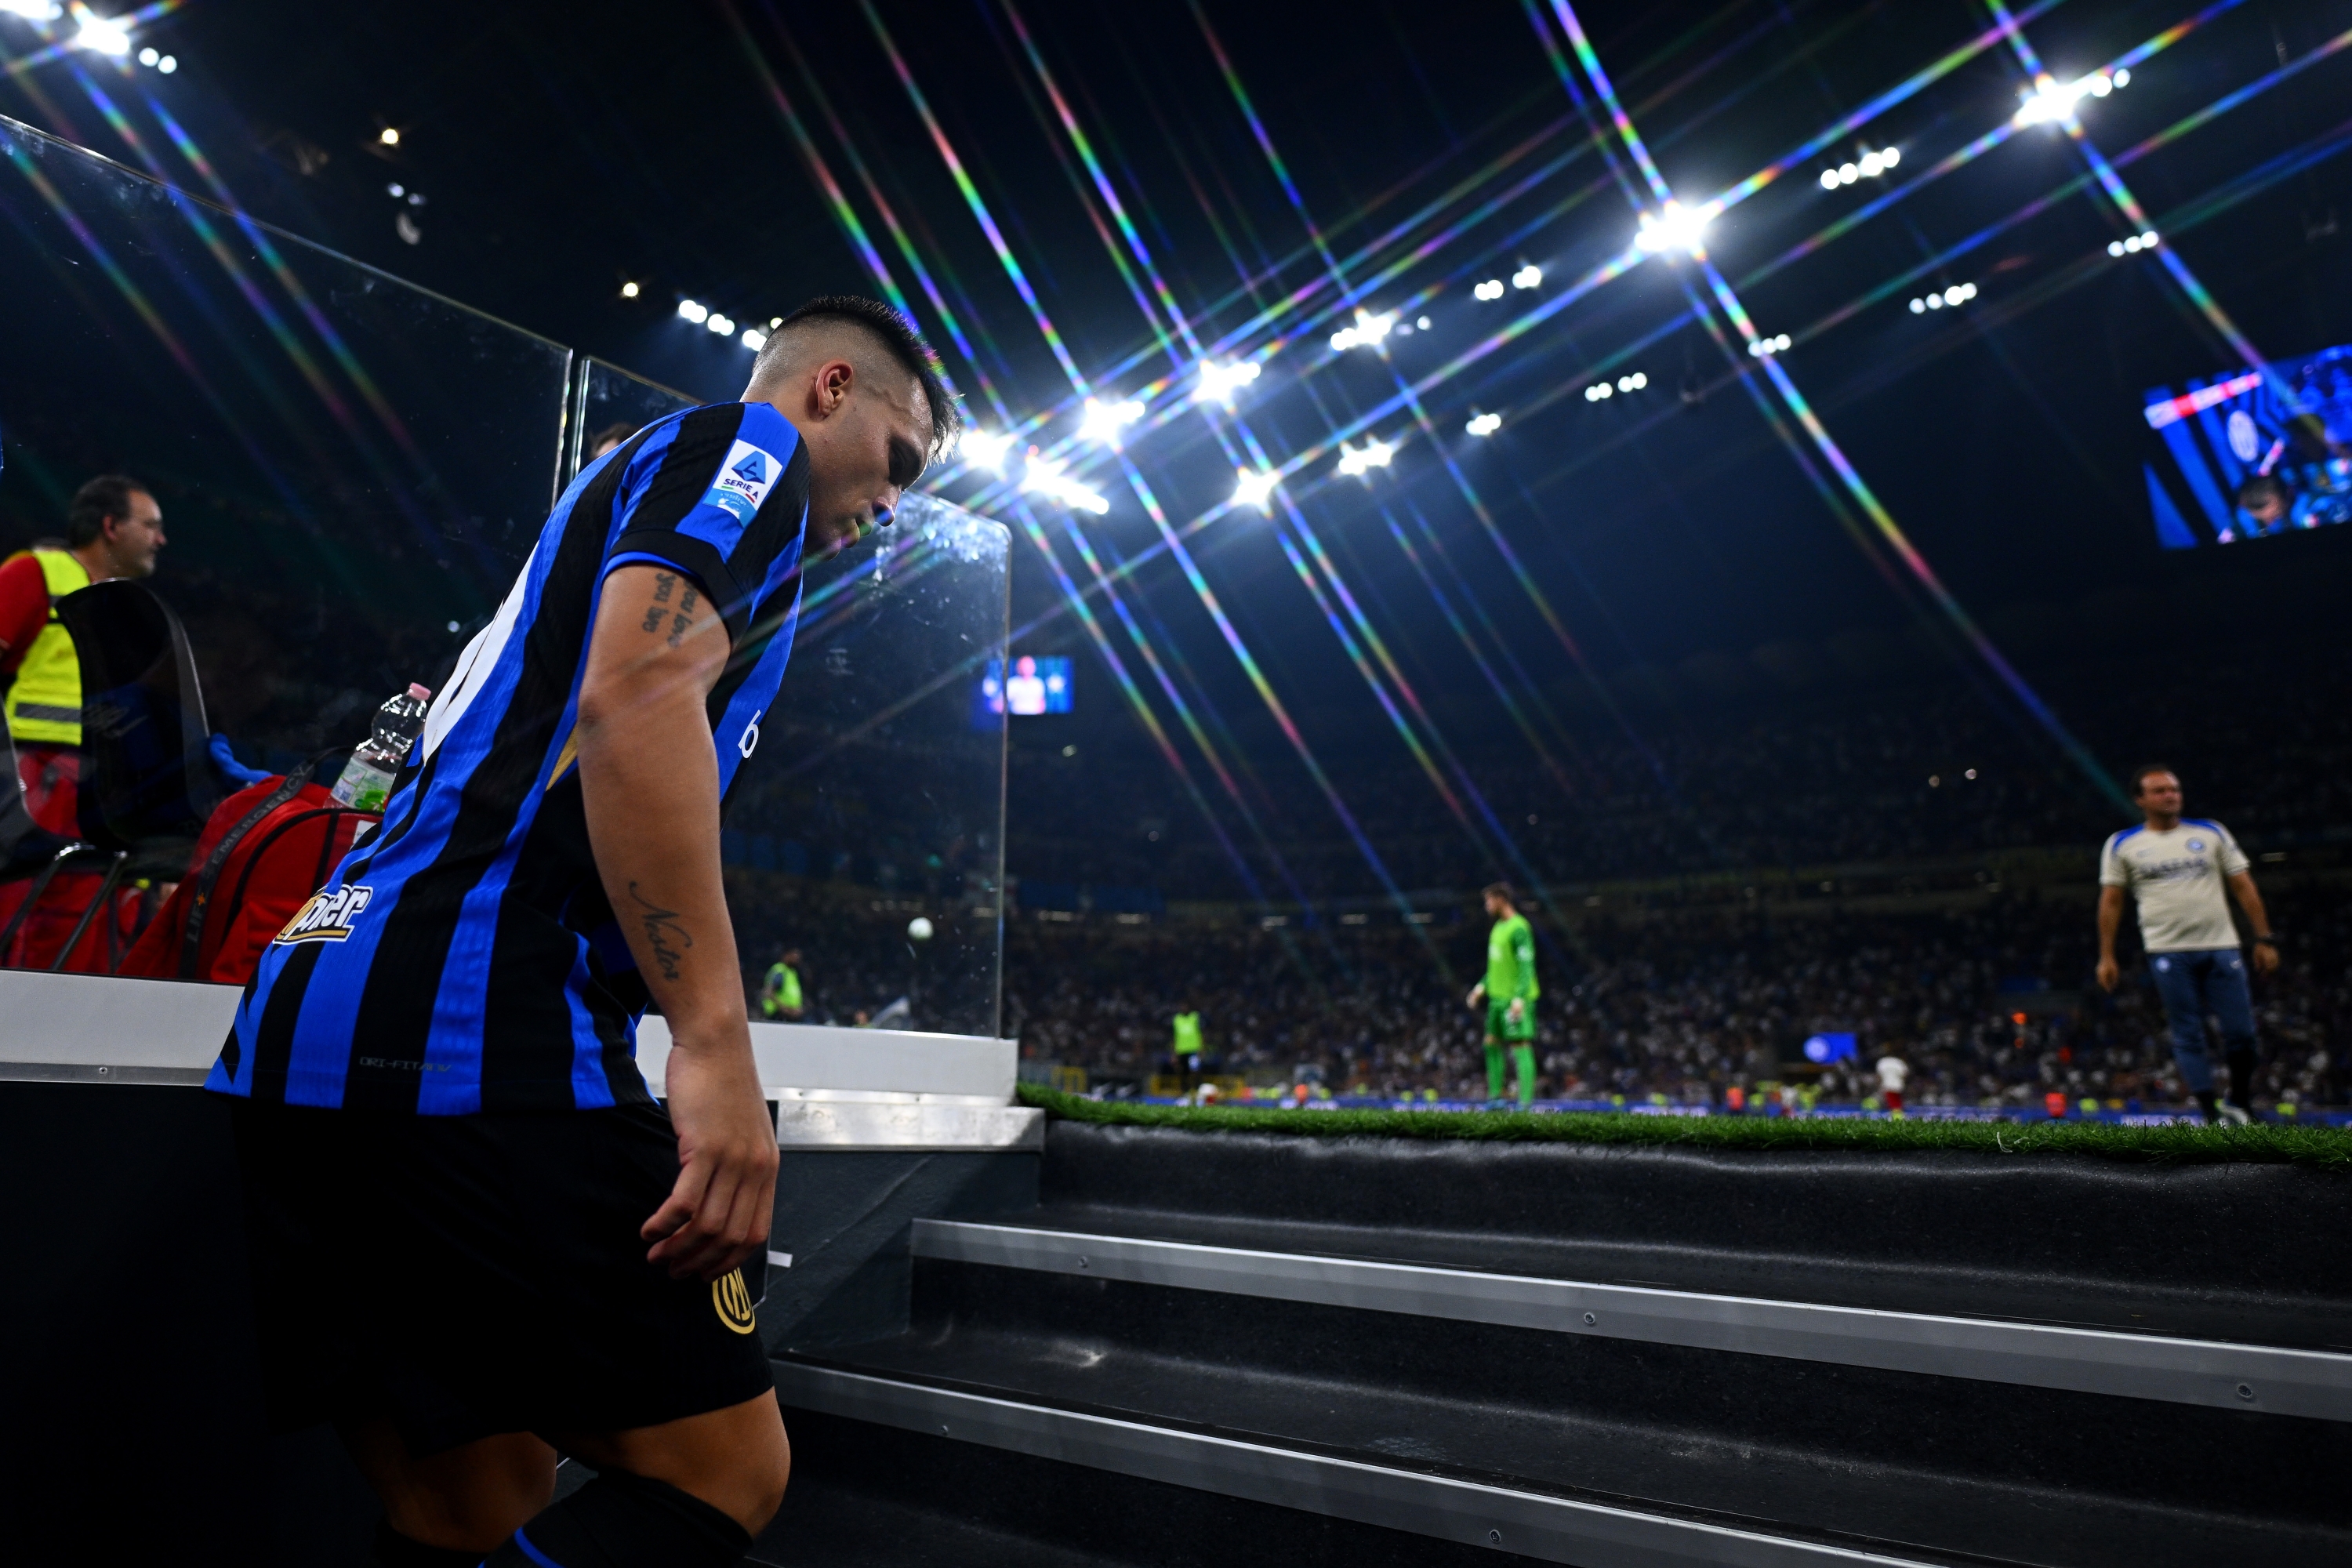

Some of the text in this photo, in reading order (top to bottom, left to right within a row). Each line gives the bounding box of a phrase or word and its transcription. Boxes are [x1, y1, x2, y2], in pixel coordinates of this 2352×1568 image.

[724, 478, 758, 499] SERIE A
[212, 766, 307, 865] EMERGENCY
